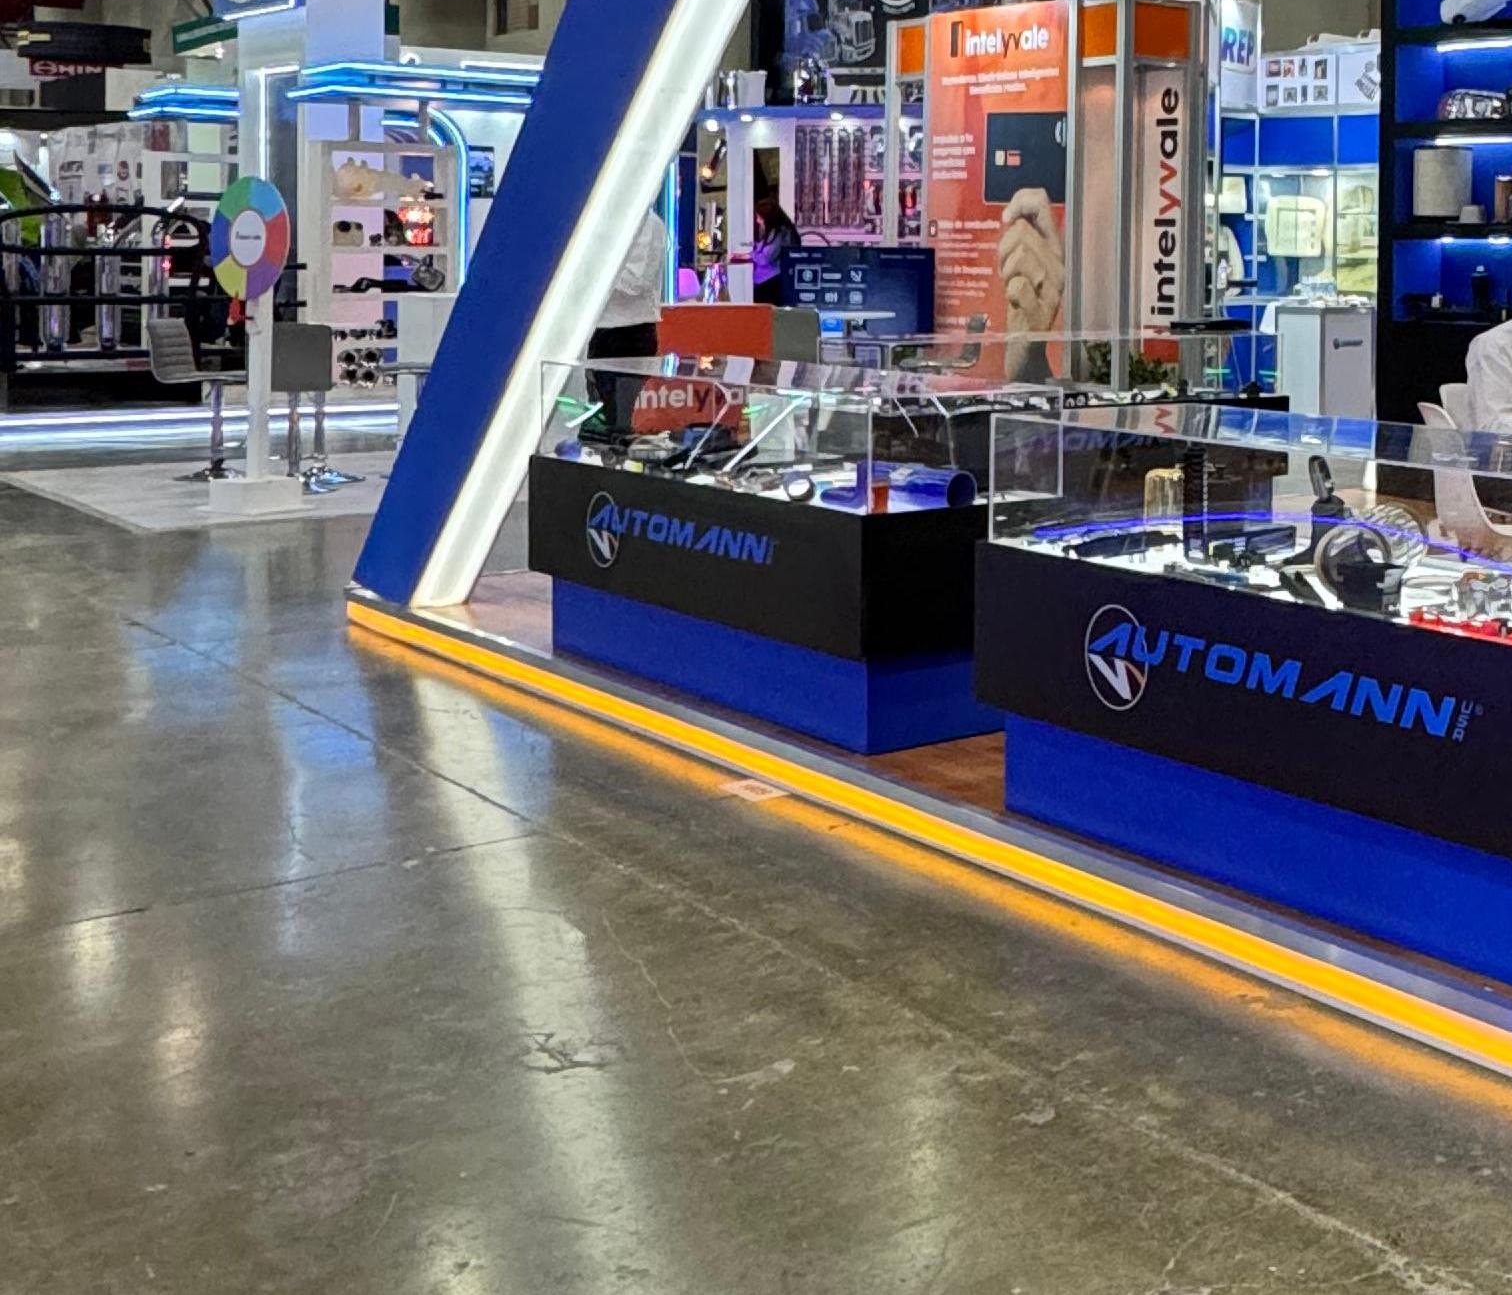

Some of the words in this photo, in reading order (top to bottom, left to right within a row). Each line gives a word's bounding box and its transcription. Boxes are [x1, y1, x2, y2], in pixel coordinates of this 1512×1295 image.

[58, 64, 103, 76] HIN
[965, 24, 1049, 58] intelyvale
[1150, 87, 1182, 316] intelyvale
[589, 504, 769, 564] AUTOMANN
[1088, 622, 1456, 738] AUTOMANN
